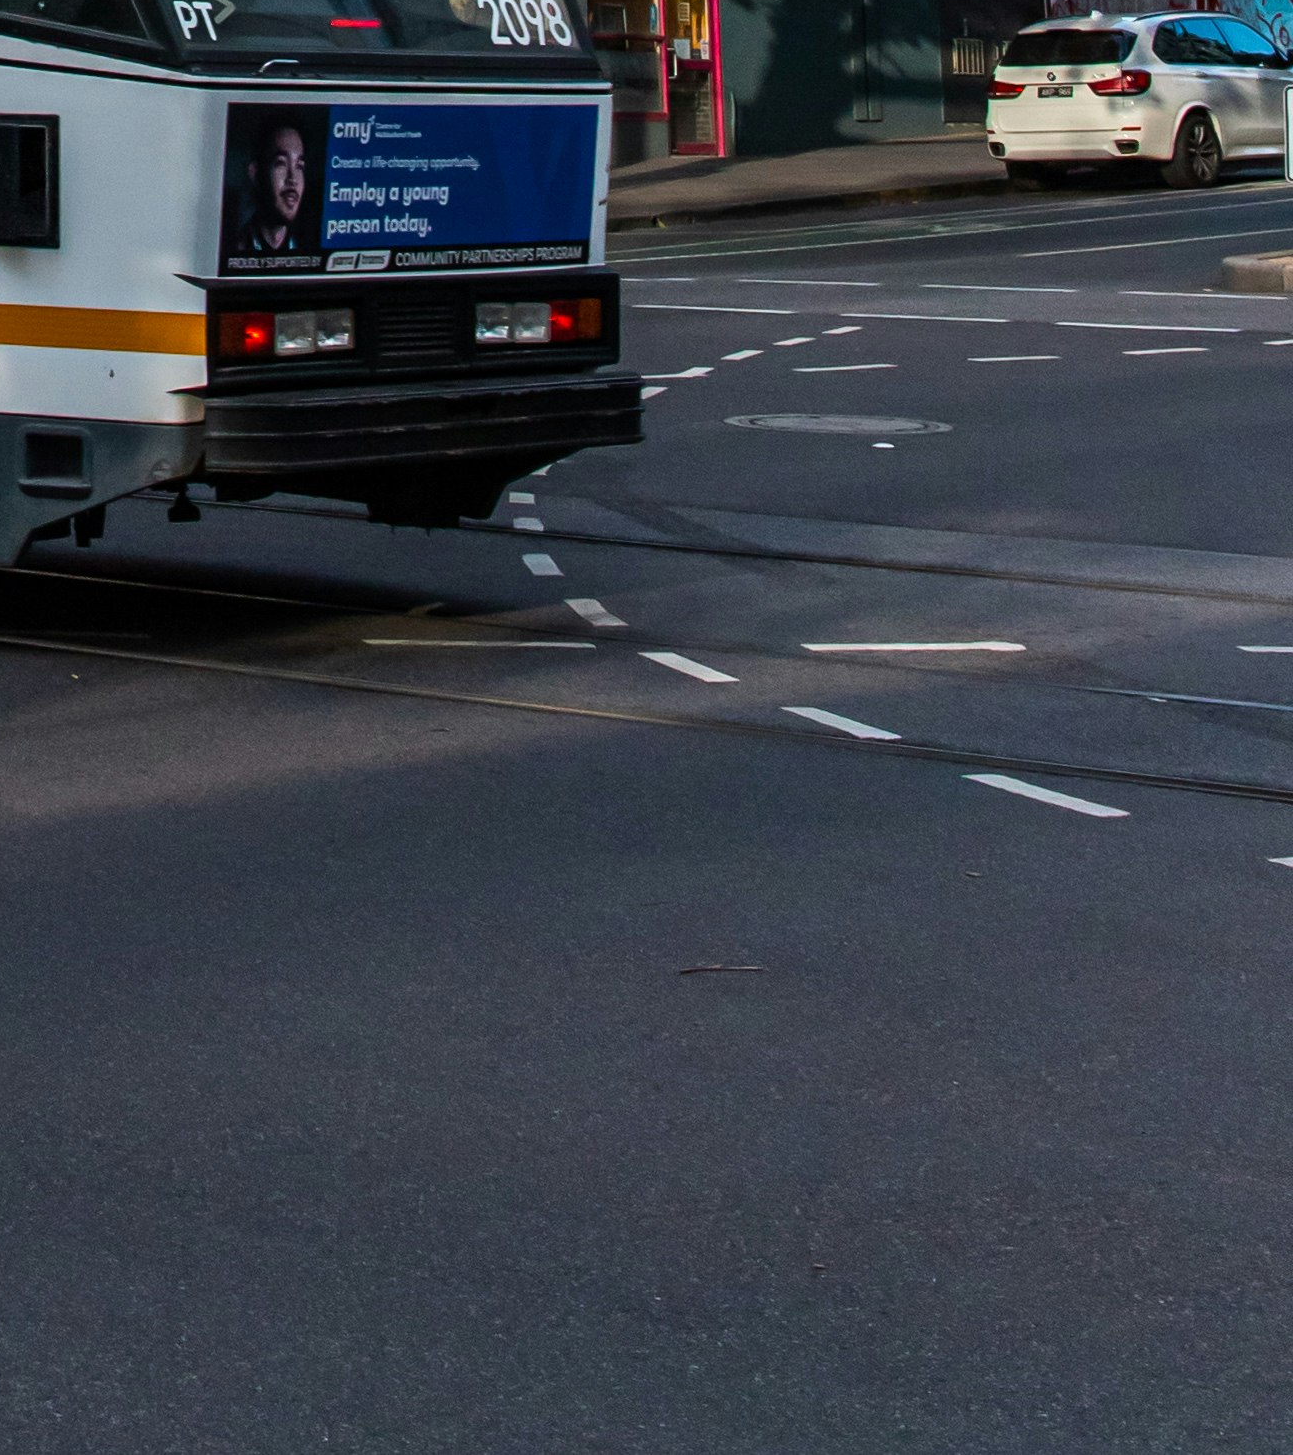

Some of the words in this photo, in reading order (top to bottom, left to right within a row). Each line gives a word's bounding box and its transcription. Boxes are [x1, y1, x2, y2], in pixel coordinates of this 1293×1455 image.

[333, 122, 371, 144] cmy
[331, 155, 362, 169] Create
[329, 181, 386, 208] Employ
[389, 186, 399, 201] a
[402, 186, 449, 206] young
[327, 218, 381, 239] person
[384, 213, 432, 238] today.
[395, 249, 460, 267] COMMUNITY
[461, 247, 534, 264] PARTNERSHIPS
[535, 245, 583, 261] PROGRAM
